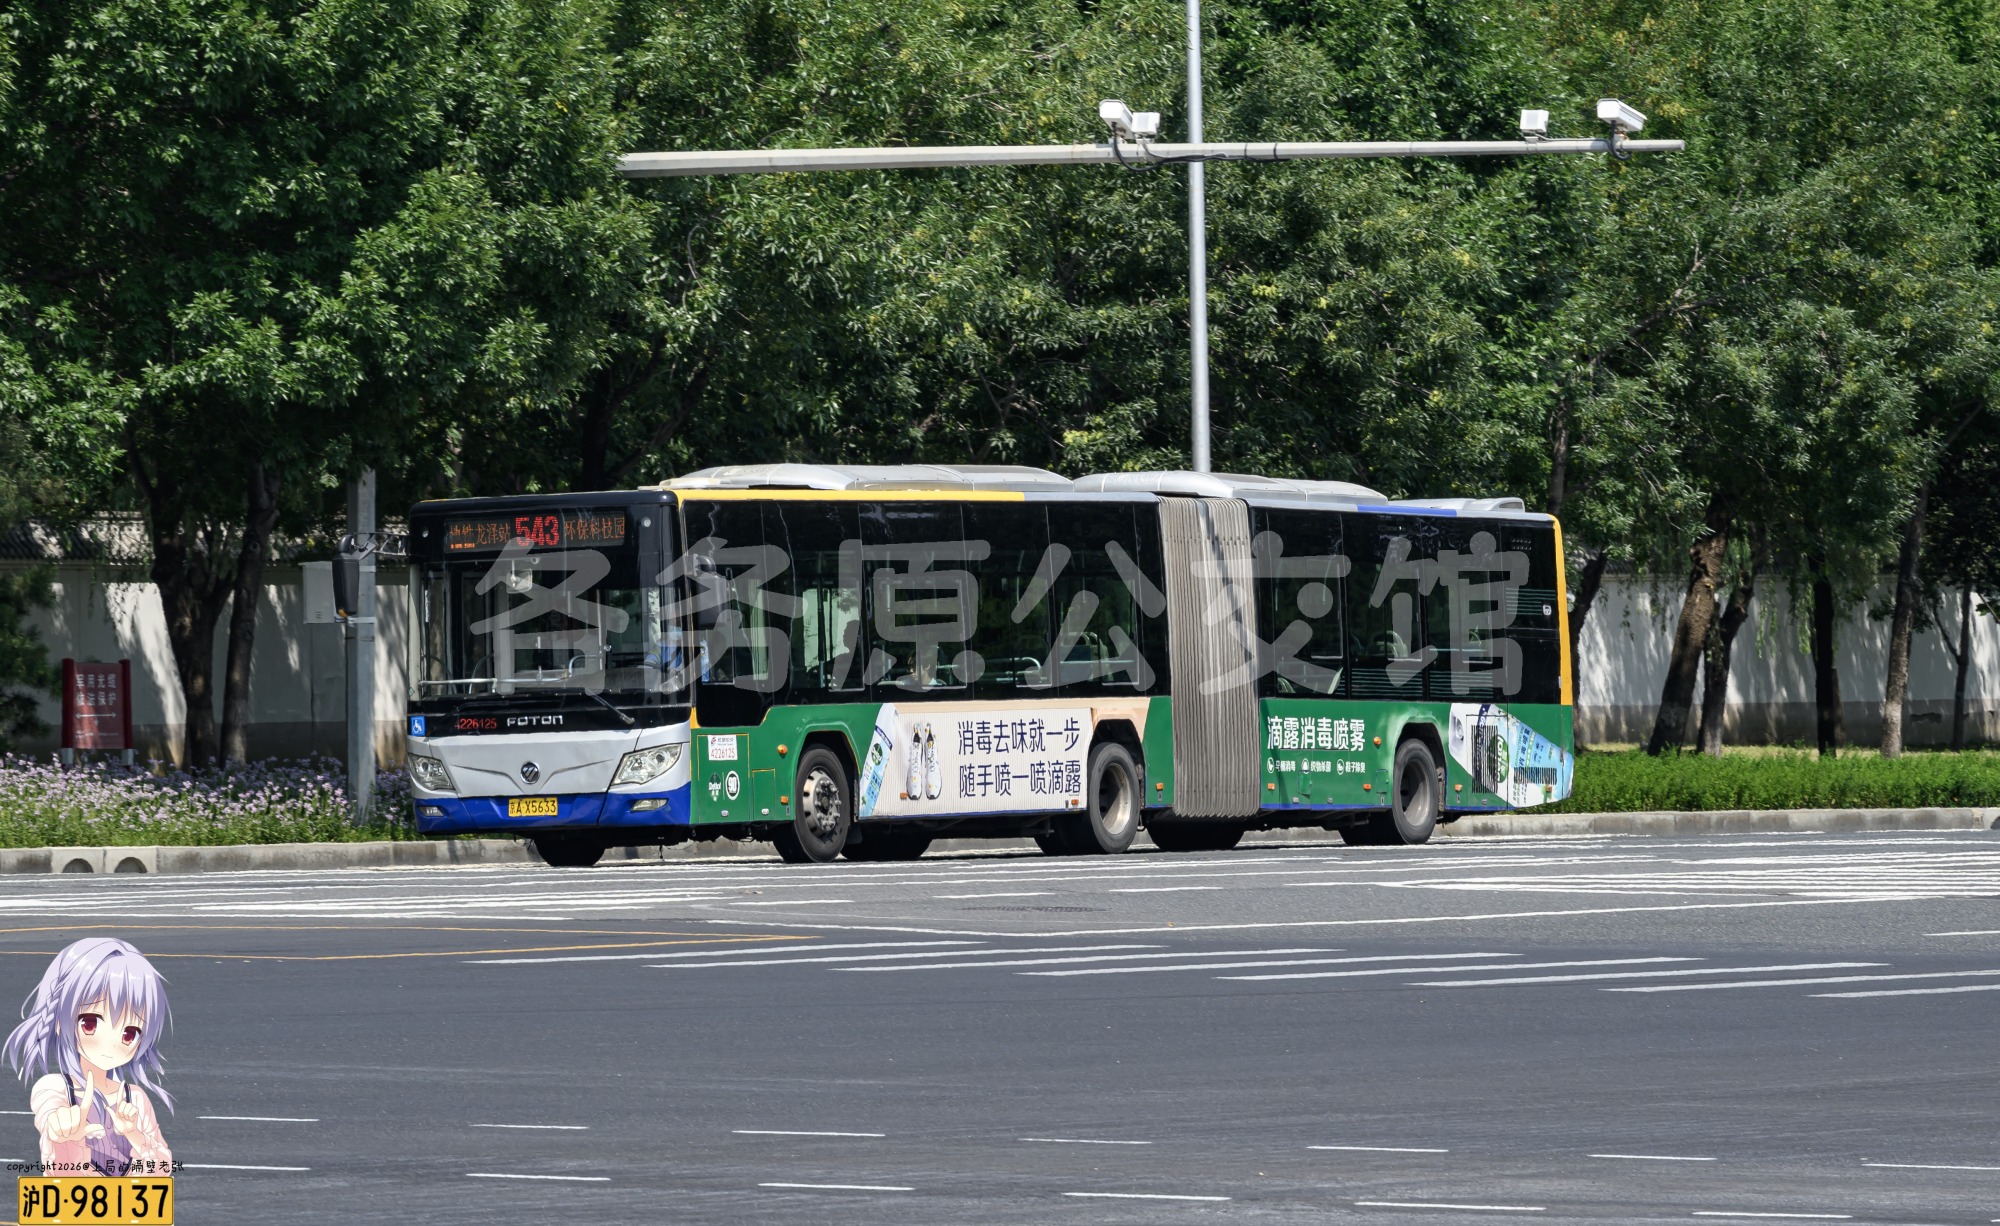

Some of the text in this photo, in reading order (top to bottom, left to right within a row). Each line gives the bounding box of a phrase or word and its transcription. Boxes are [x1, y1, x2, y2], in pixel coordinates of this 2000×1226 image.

[515, 516, 560, 547] 543
[565, 516, 626, 541] 环保科技园
[507, 715, 563, 726] FOTON
[1267, 715, 1366, 752] 滴露消毒喷雾
[957, 717, 1081, 755] 消毒去味就一步
[710, 747, 736, 759] 4226125
[958, 760, 1083, 799] 随手喷一喷滴露
[509, 799, 557, 814] 京A·X5633
